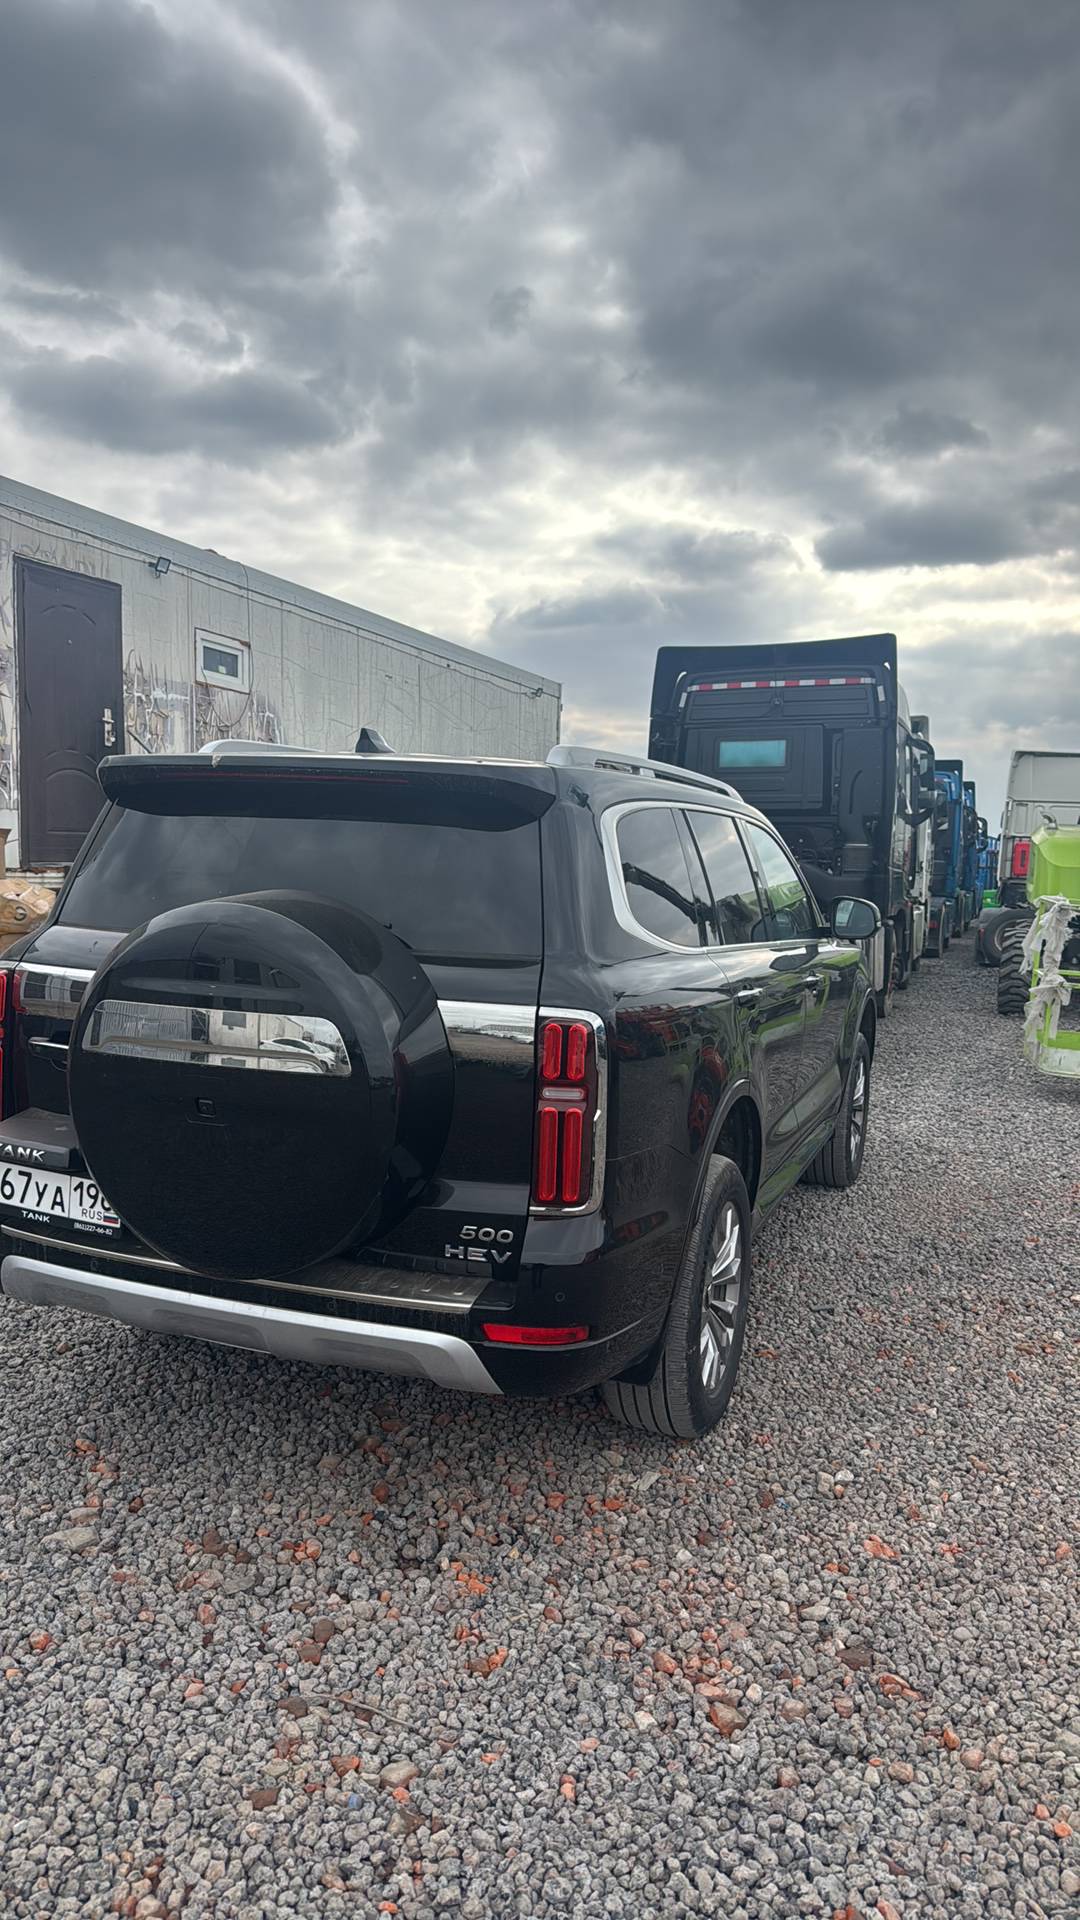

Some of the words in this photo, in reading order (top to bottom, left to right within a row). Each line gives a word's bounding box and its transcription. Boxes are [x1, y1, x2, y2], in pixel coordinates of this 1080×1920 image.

[0, 1143, 45, 1161] ANK
[21, 1210, 50, 1223] TANK
[81, 1208, 103, 1221] RUS
[459, 1225, 514, 1243] 500
[444, 1244, 512, 1263] HEV
